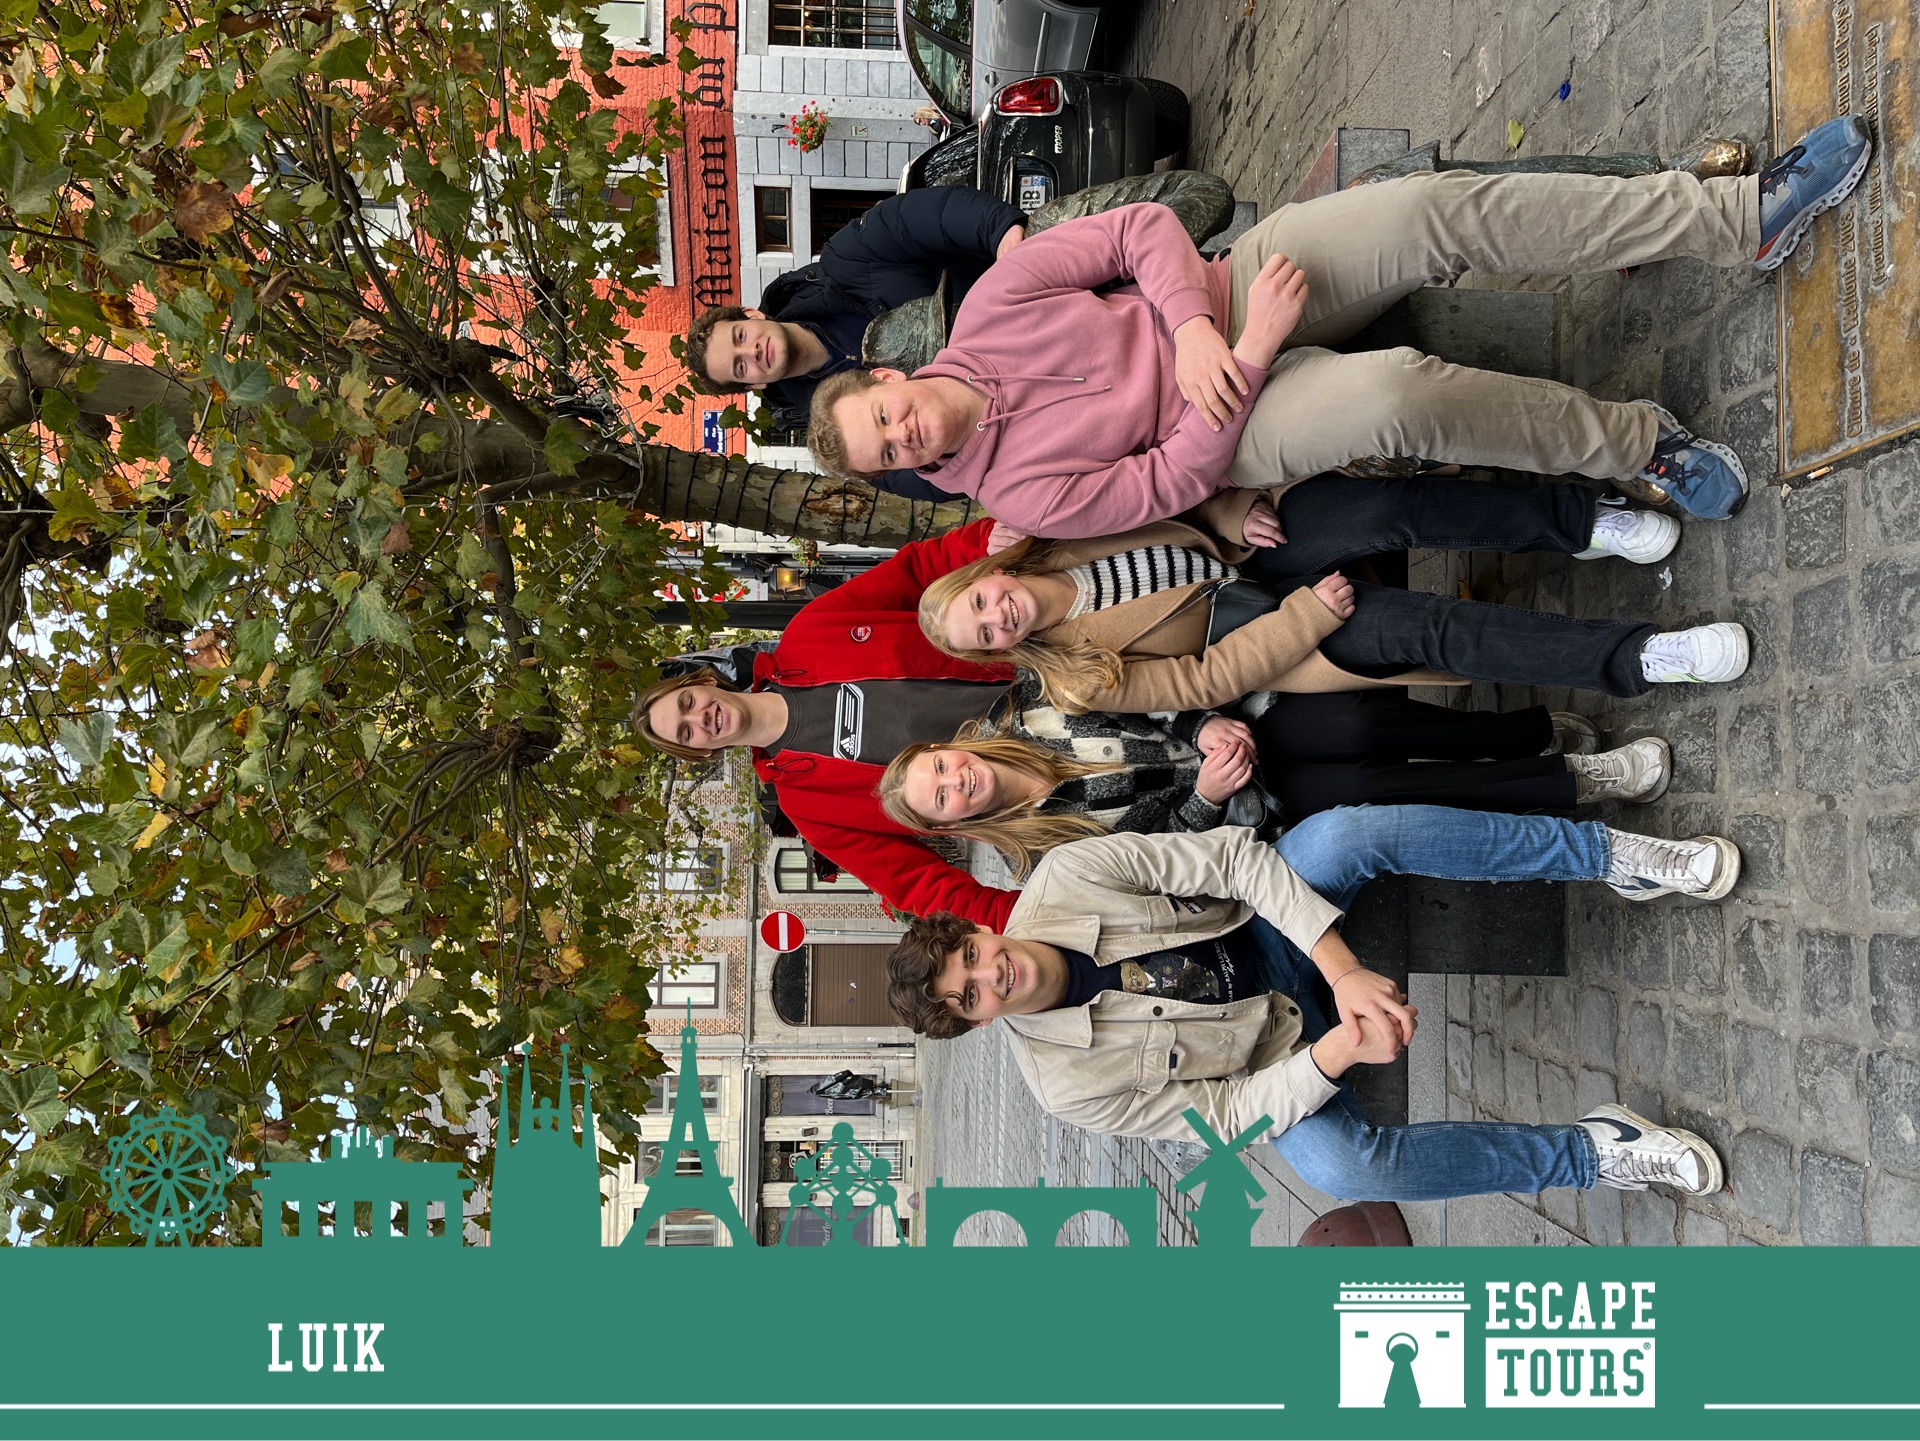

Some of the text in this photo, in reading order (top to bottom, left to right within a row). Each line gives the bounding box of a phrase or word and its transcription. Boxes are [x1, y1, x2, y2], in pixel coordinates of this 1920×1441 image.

[1834, 4, 1852, 48] Pays
[1836, 48, 1849, 71] au
[692, 56, 726, 110] du
[1054, 125, 1063, 154] COOPER
[1868, 180, 1881, 215] Ville
[692, 135, 732, 308] Maison
[1842, 257, 1858, 333] Wallonie
[1844, 350, 1860, 373] de
[1214, 941, 1225, 964] LAUREN
[1220, 963, 1230, 982] RALPH
[825, 1098, 834, 1115] Beer
[821, 1206, 832, 1247] BeerLoers
